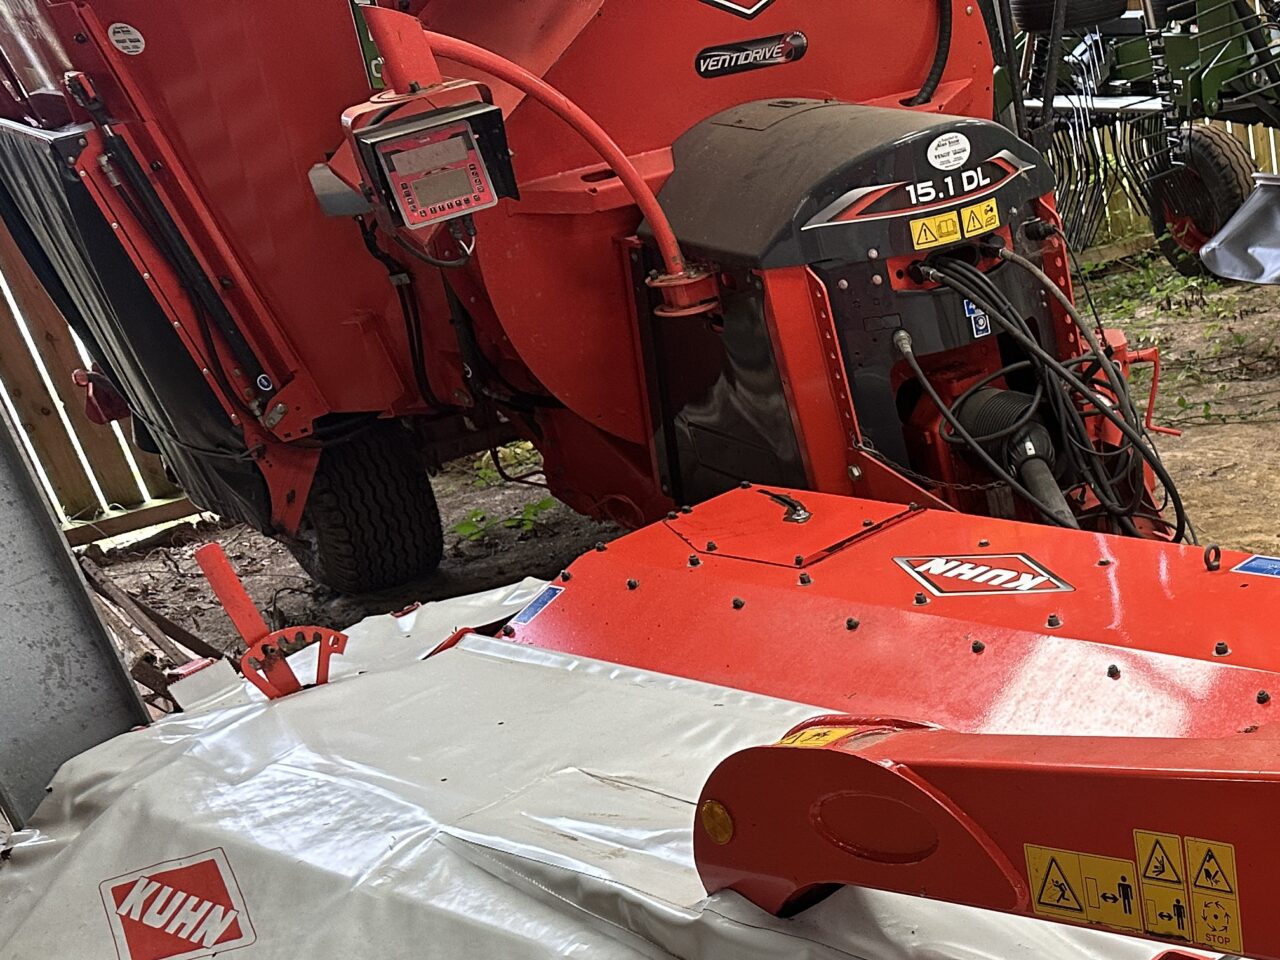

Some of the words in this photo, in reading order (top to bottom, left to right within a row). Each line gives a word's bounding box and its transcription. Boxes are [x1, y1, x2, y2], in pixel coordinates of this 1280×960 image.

[700, 44, 784, 72] VENTIDRIVE
[905, 176, 955, 204] 15.1
[961, 166, 991, 192] DL
[914, 557, 1049, 591] KUHN
[116, 876, 240, 949] KUHN
[1205, 933, 1231, 946] STOP
